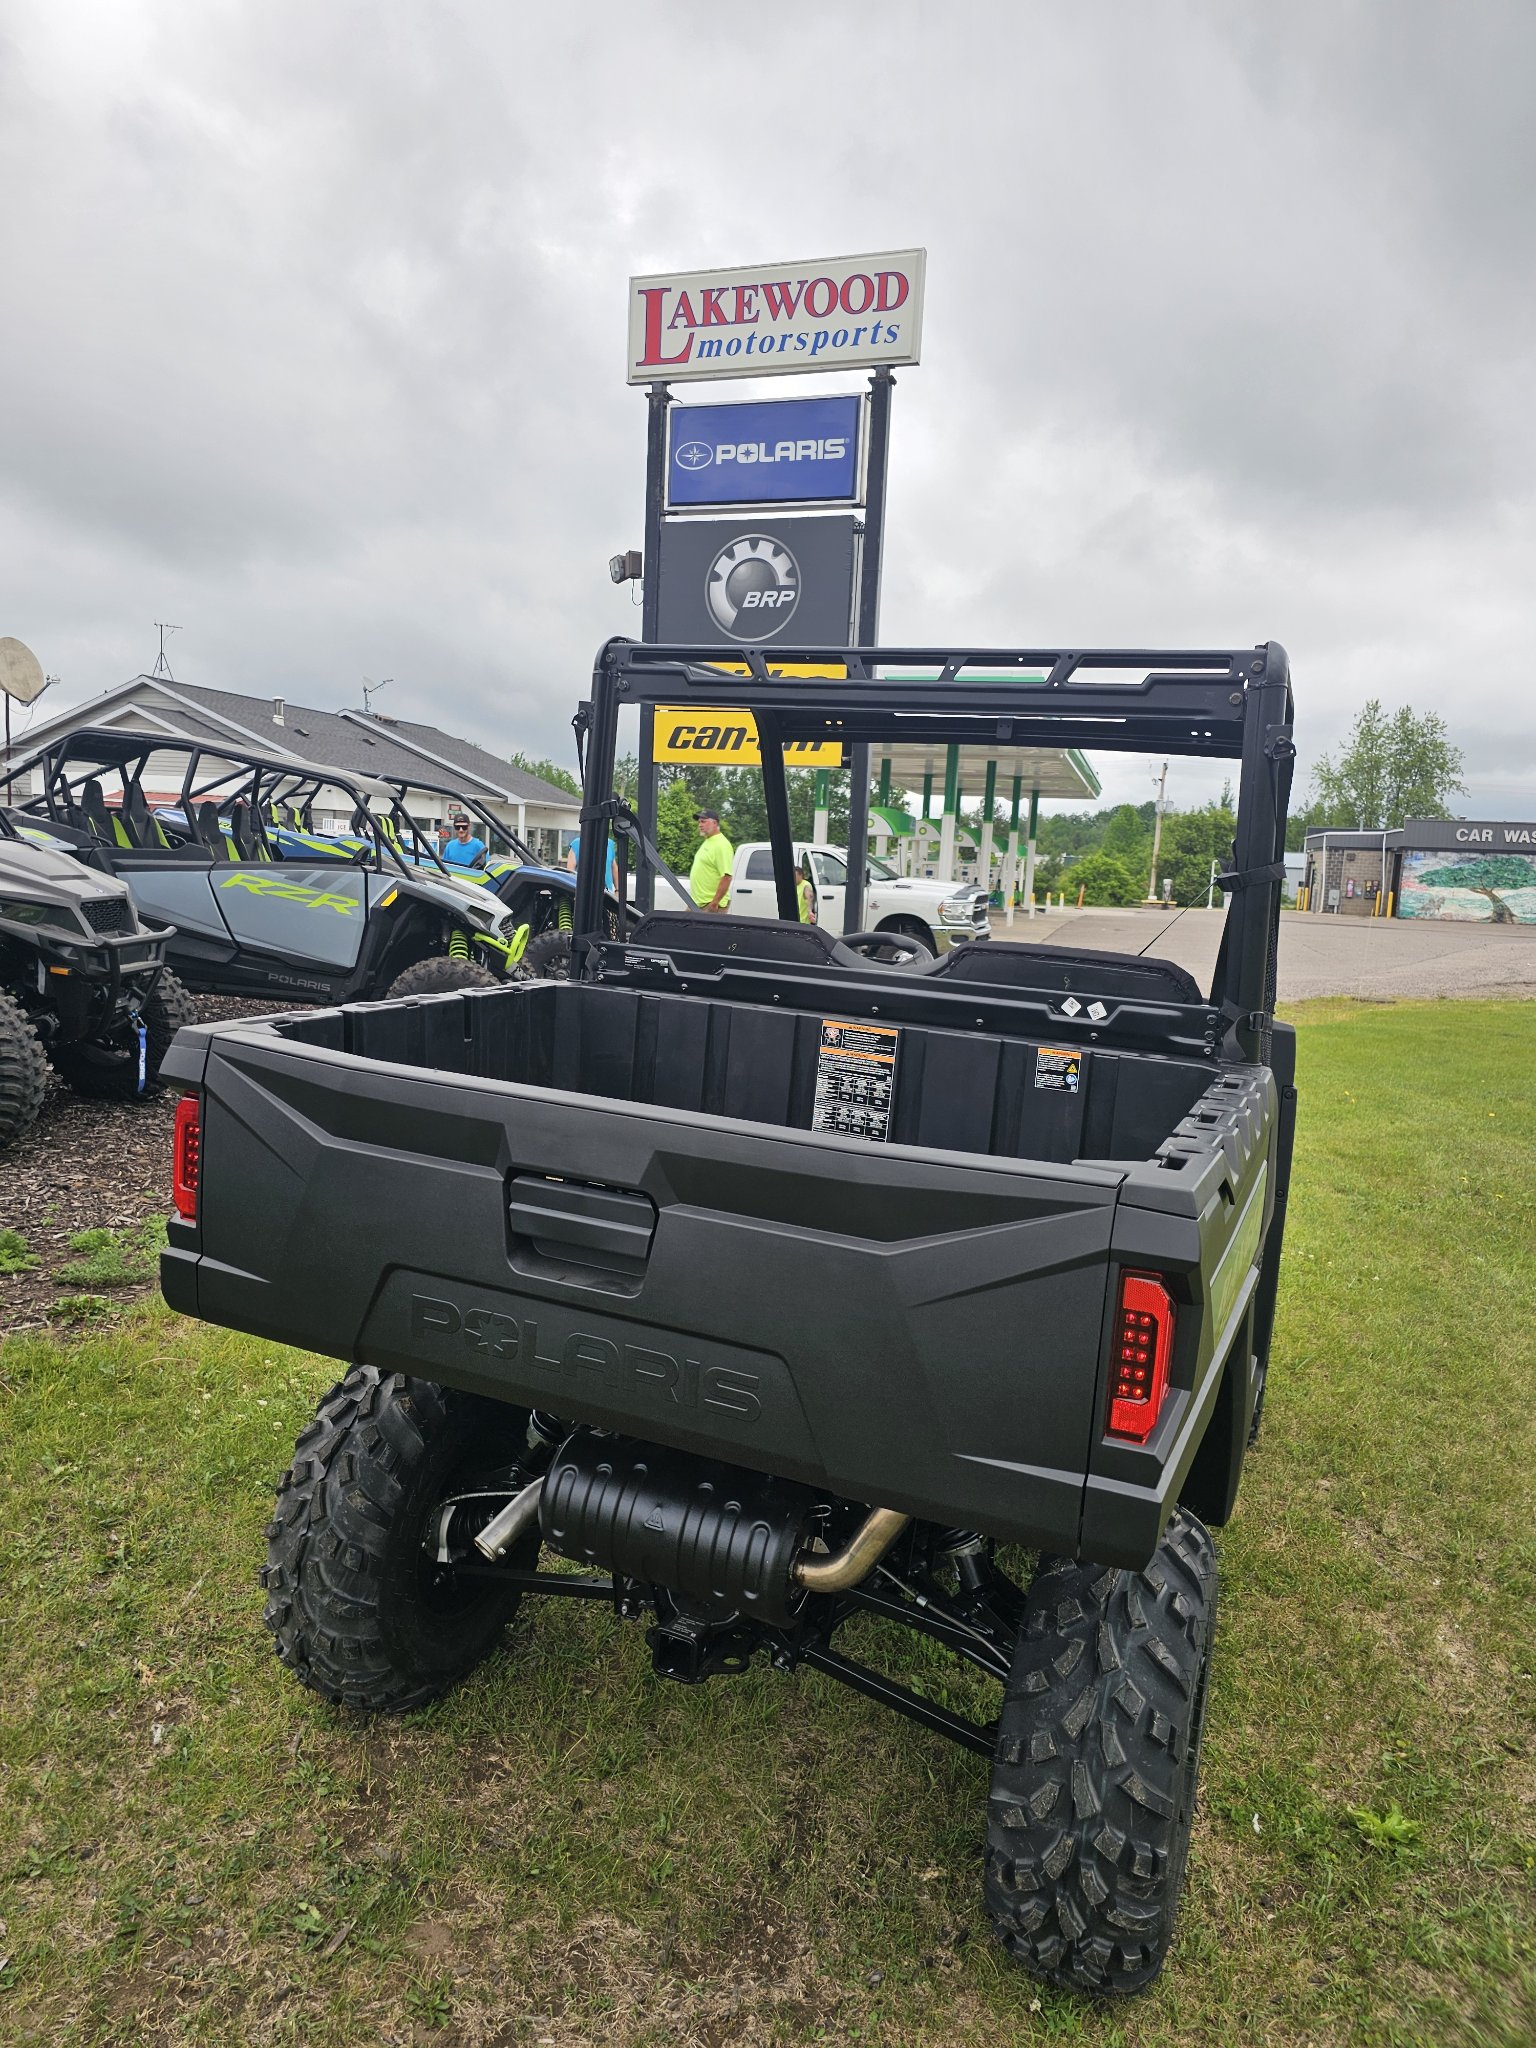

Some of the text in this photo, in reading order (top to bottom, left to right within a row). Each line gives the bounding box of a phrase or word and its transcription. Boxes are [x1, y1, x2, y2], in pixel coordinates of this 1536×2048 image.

[636, 271, 910, 366] LAKEWOOD
[696, 319, 901, 357] motorsports
[716, 438, 846, 465] POLARIS
[742, 590, 796, 608] BRP
[667, 726, 823, 752] can-
[1455, 828, 1493, 842] CAR
[220, 872, 360, 916] RZR
[267, 972, 331, 992] POLARIS
[412, 1293, 762, 1422] POLARIS
